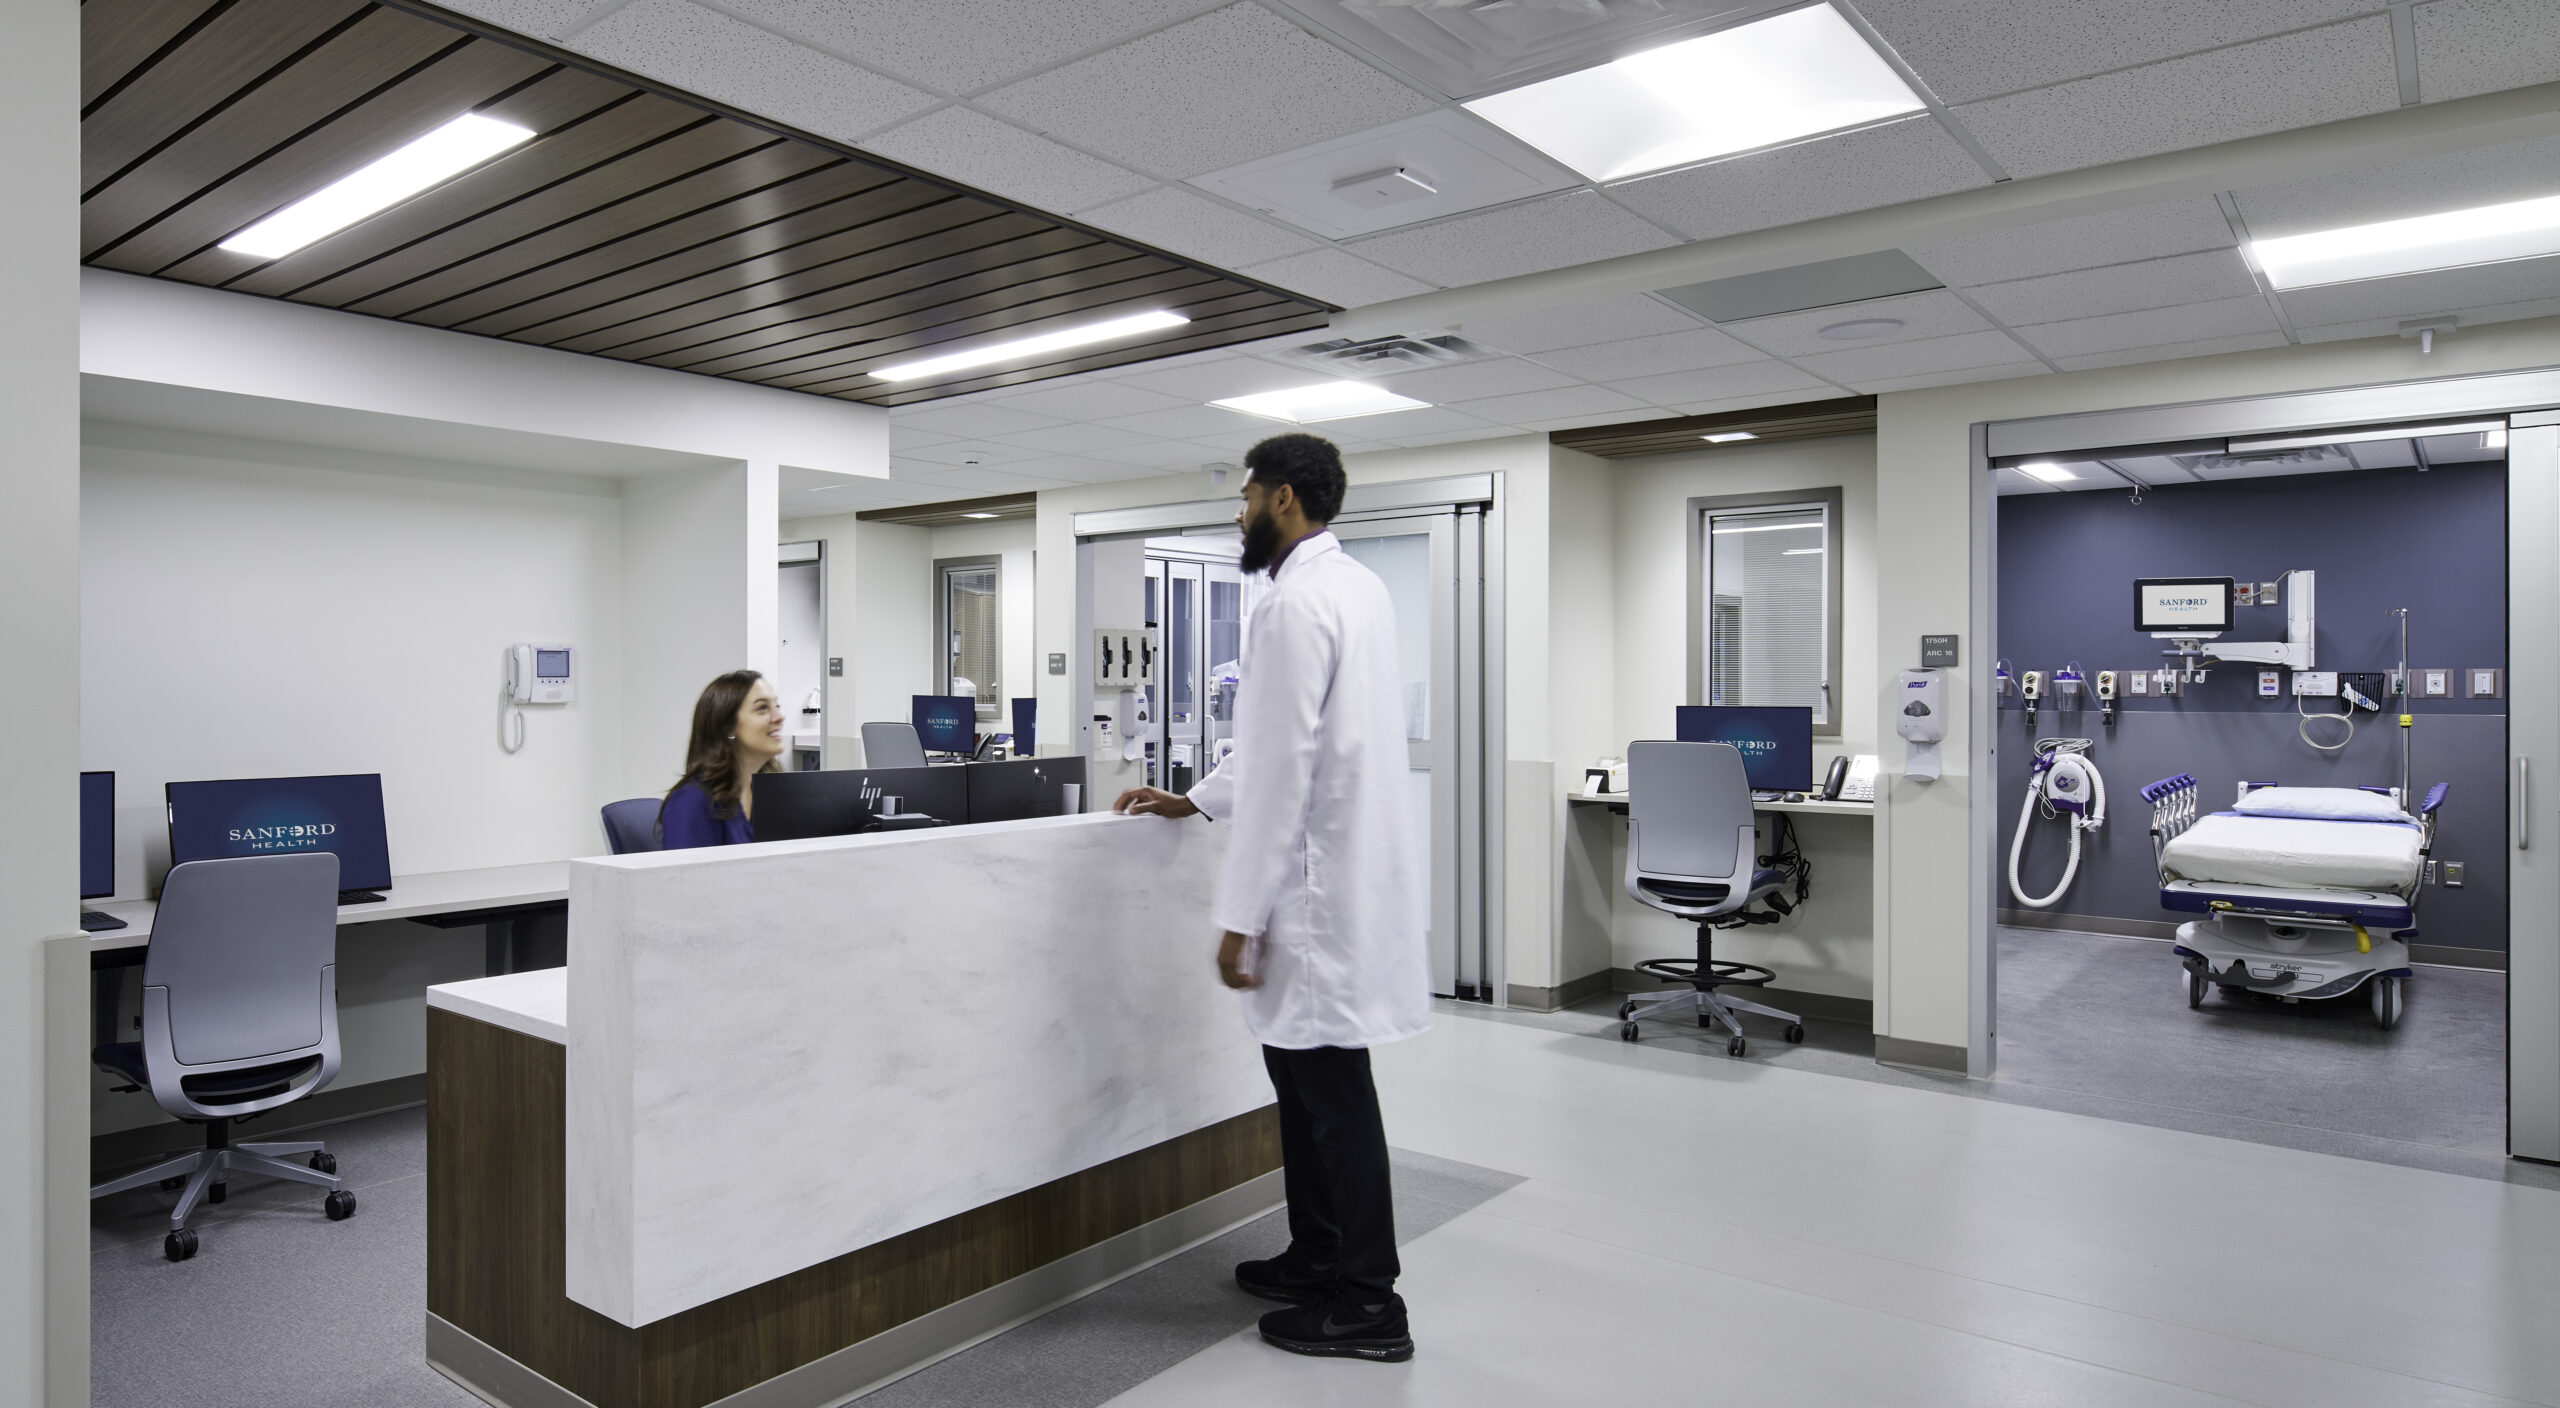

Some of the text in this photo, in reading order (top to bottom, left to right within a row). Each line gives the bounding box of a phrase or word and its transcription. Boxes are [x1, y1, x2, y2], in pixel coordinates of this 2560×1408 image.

[2159, 598, 2208, 606] SANFORD
[229, 823, 336, 841] SANFORD
[252, 839, 317, 849] HEALTH
[2269, 963, 2303, 972] stryker
